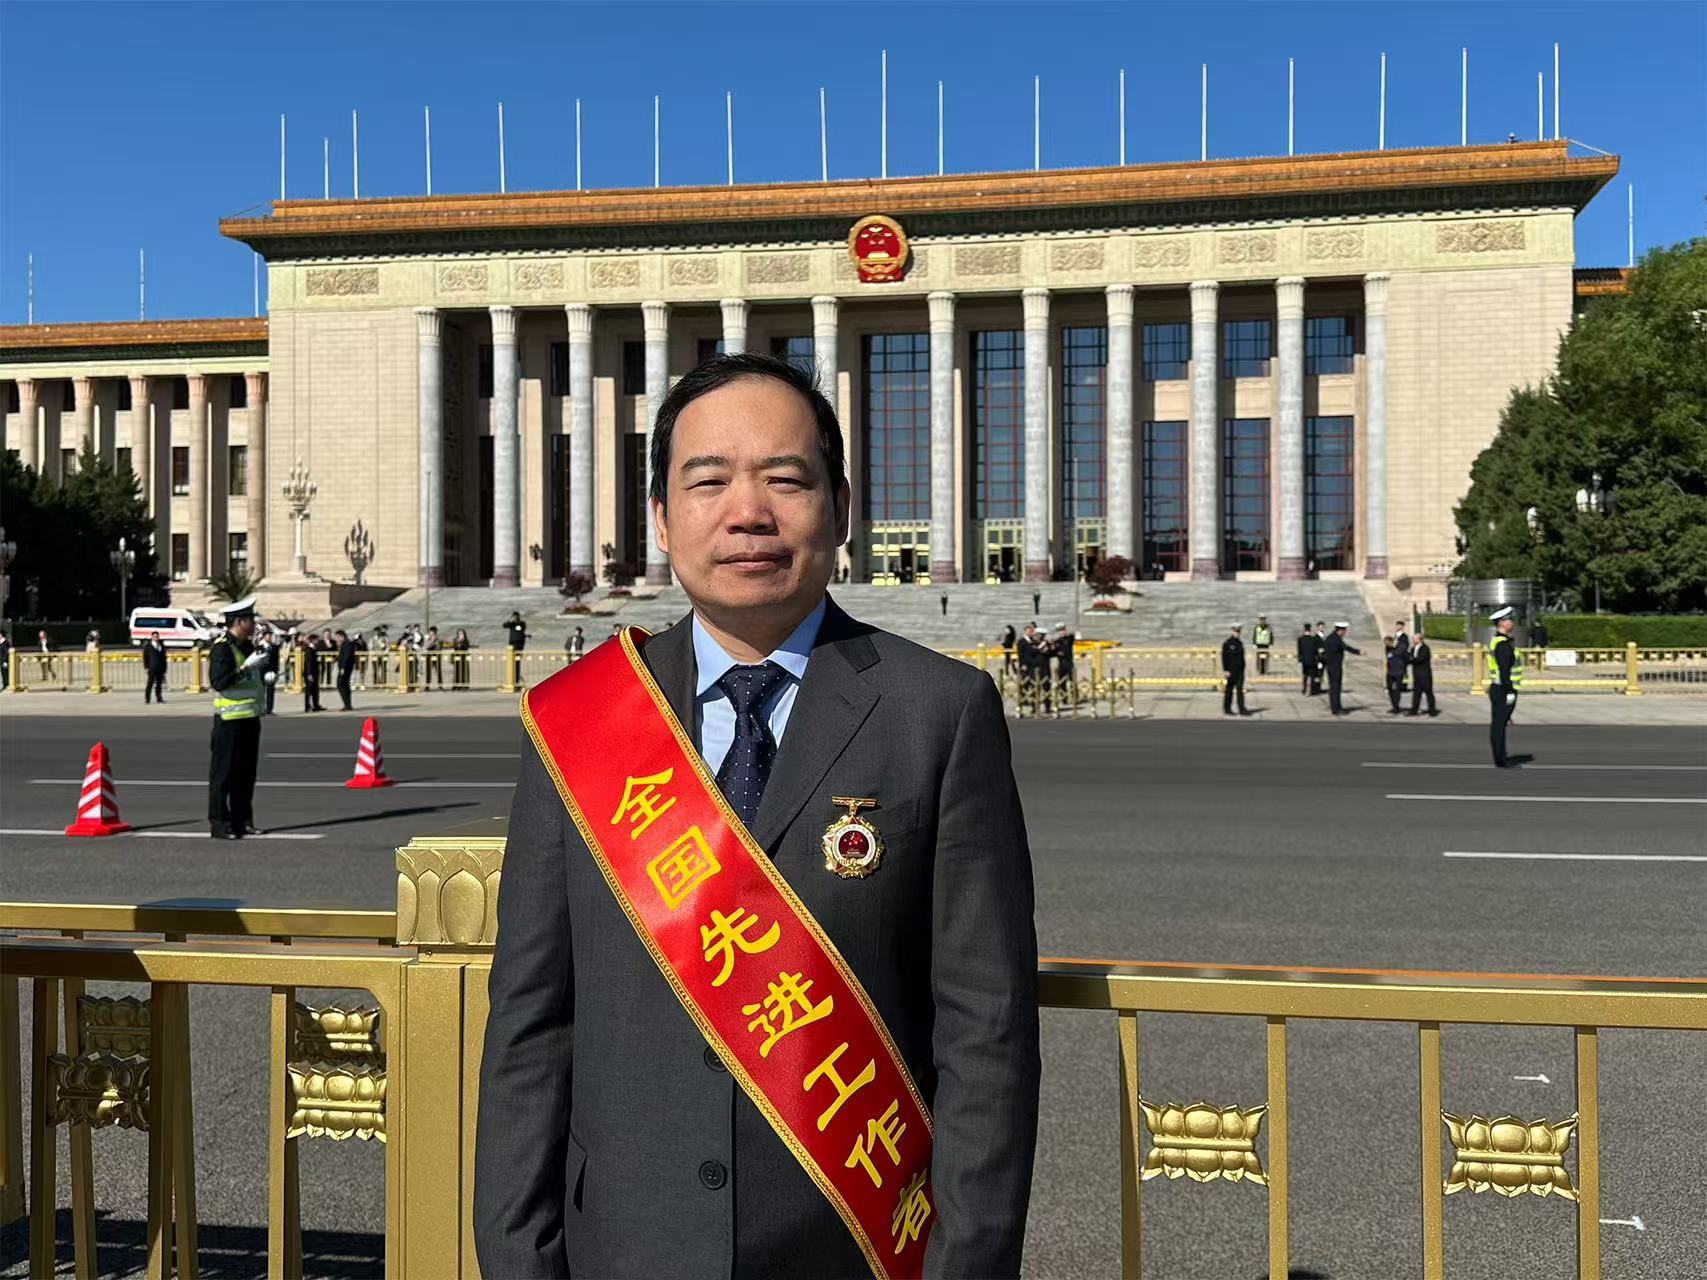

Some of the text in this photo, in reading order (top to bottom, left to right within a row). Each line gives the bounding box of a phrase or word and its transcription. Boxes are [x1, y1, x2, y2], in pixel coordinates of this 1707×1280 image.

[611, 767, 931, 1254] 全国先进工作者
